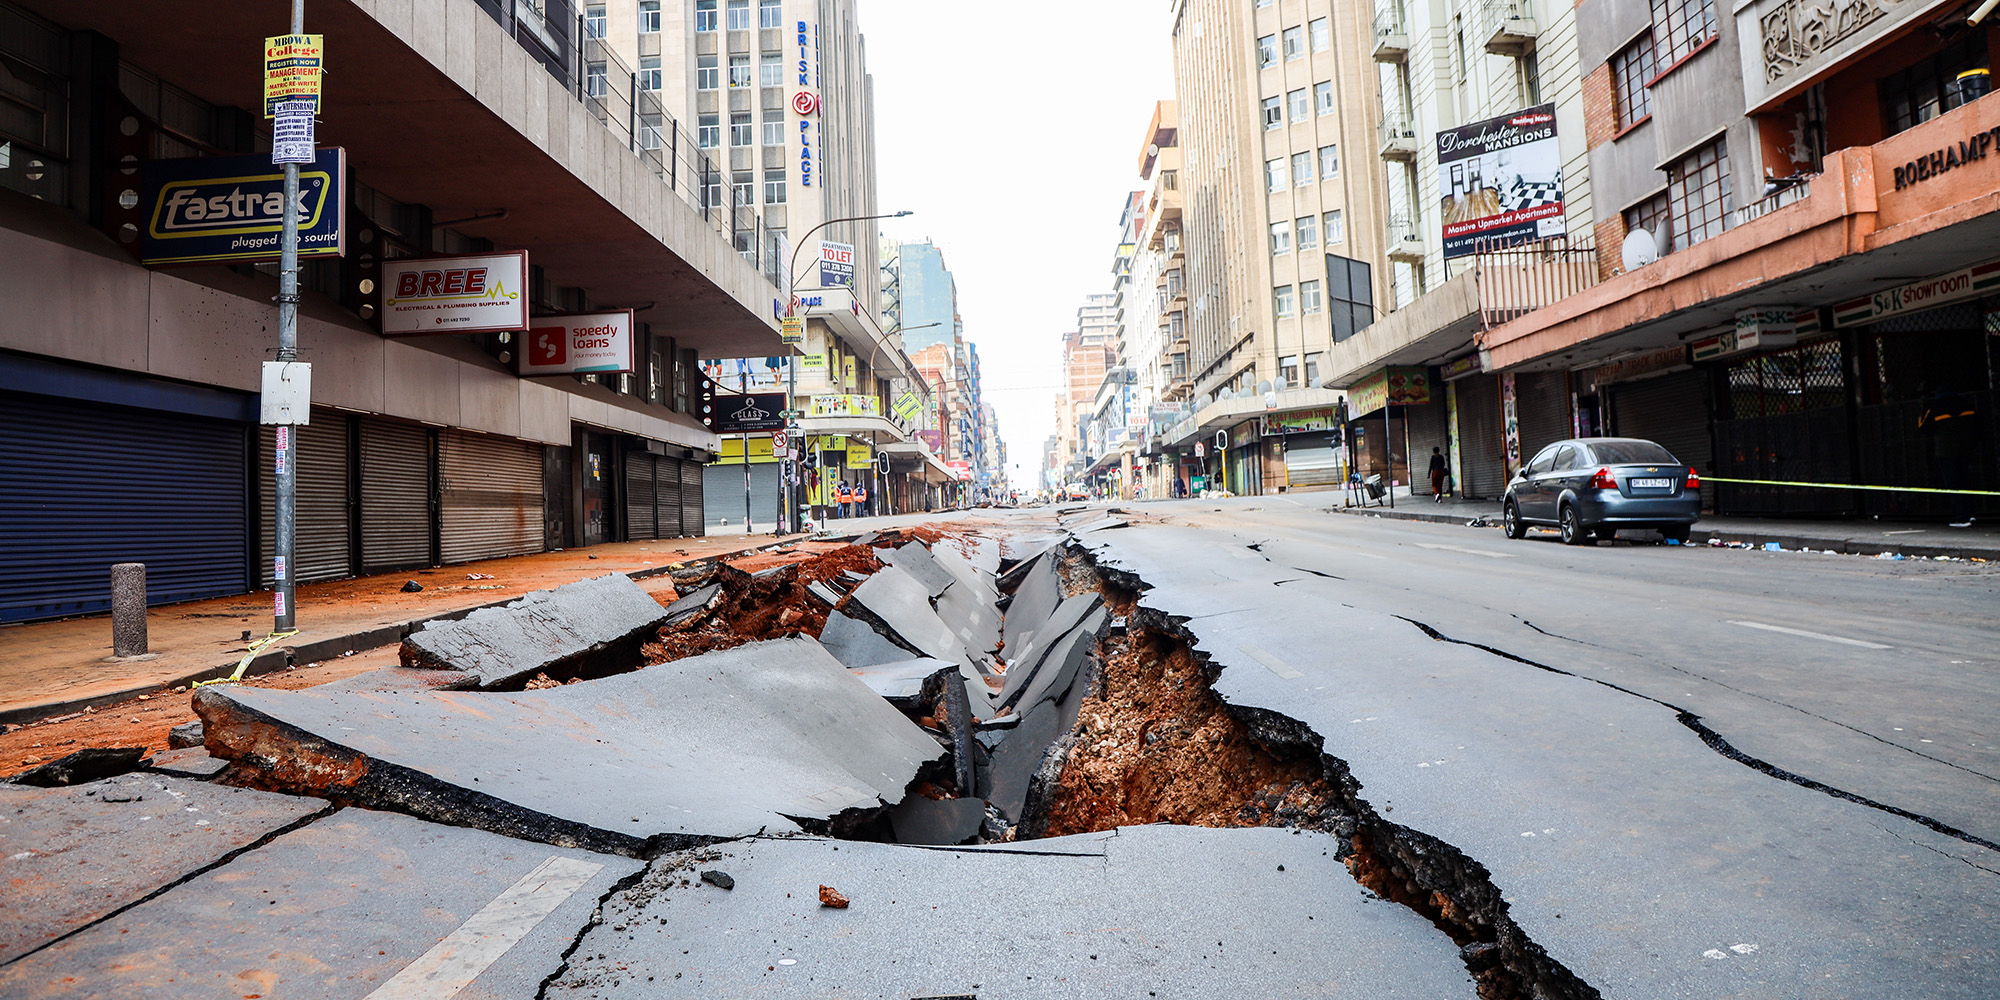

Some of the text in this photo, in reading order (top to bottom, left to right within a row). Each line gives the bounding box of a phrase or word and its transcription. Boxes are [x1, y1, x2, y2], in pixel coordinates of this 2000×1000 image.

[274, 36, 311, 47] MBOWA
[267, 45, 319, 57] College
[270, 60, 298, 68] REGISTER
[270, 68, 318, 78] MANAGEMENT
[797, 21, 811, 186] BRISK PLACE
[1512, 116, 1534, 125] Renting
[1439, 125, 1518, 154] Dorchester
[1485, 128, 1552, 152] MANSIONS
[1447, 206, 1558, 234] Massive Upmarket Apartments
[231, 234, 278, 249] plugged
[305, 230, 338, 243] sound
[822, 242, 852, 252] APARTMENTS
[822, 248, 852, 263] TO LET
[395, 267, 488, 298] BREE
[1903, 272, 1969, 304] showroom
[801, 296, 822, 306] PLACE
[395, 304, 435, 312] ELECTRICAL
[573, 324, 618, 338] speedy
[1762, 328, 1793, 337] showroom
[573, 337, 610, 349] loans
[737, 410, 763, 418] CLASS
[1315, 408, 1334, 417] STORE
[1140, 417, 1149, 425] LE
